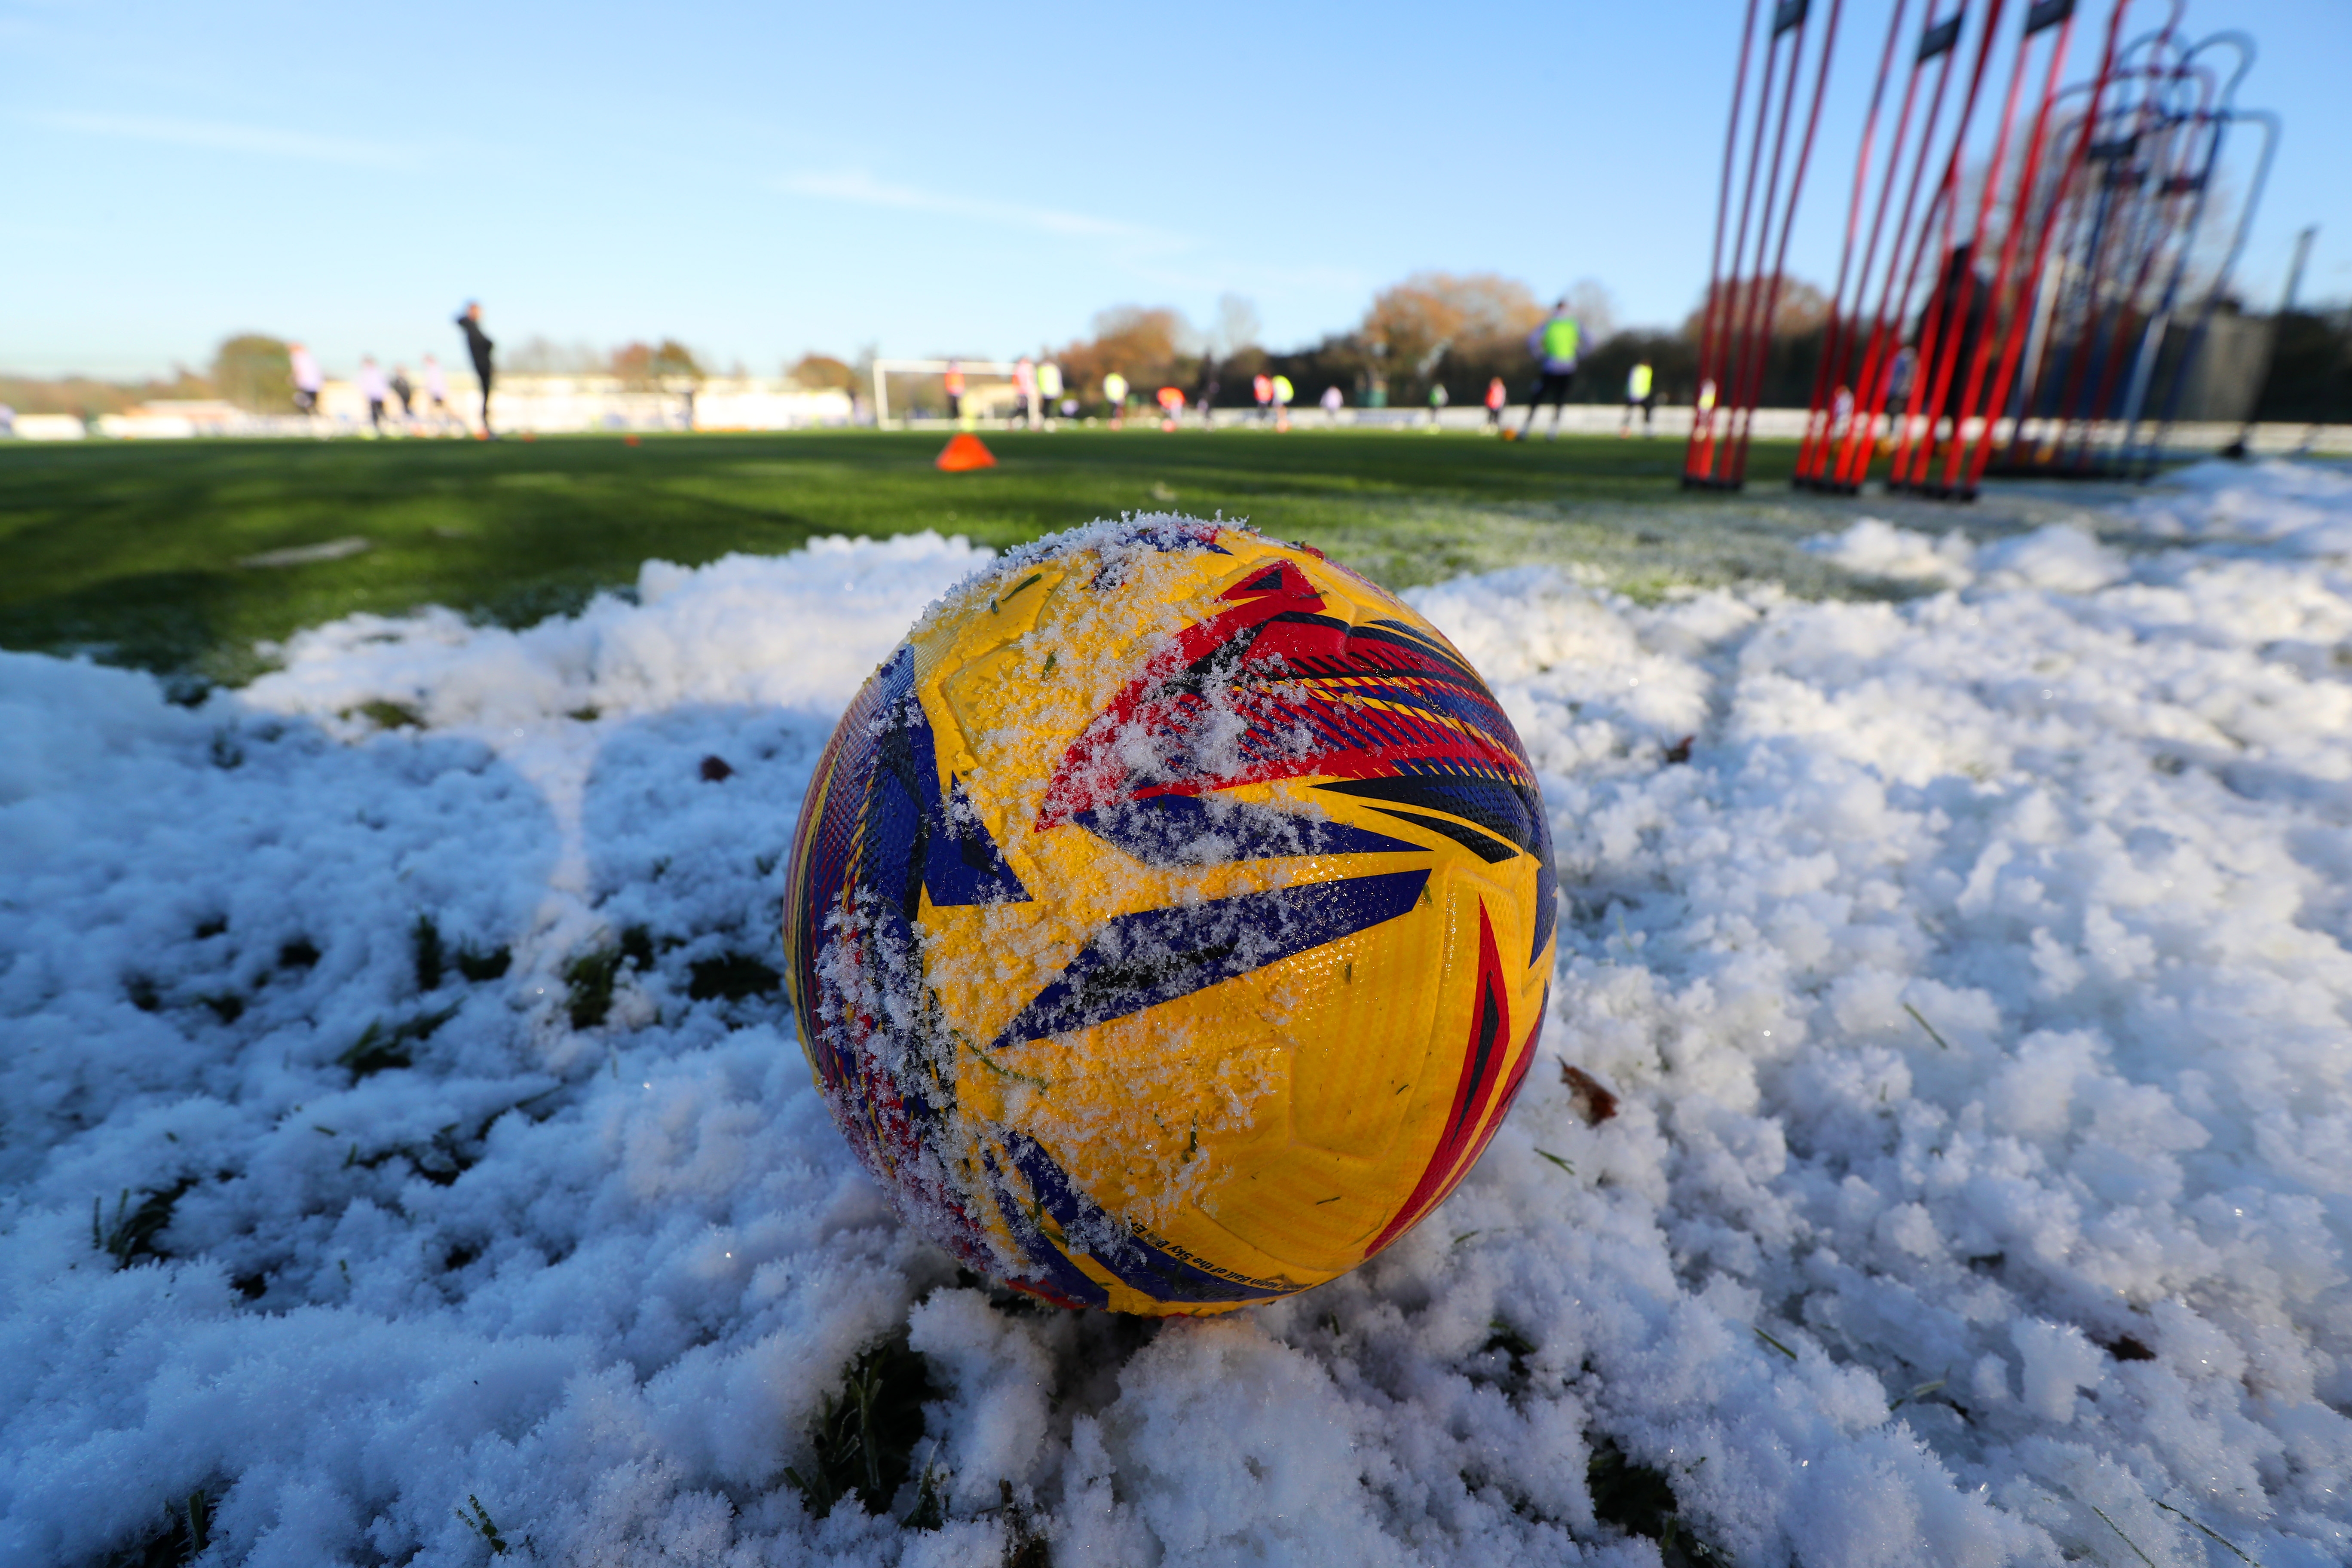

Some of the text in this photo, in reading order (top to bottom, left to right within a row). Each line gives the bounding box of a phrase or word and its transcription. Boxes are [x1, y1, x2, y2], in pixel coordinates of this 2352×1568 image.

[1167, 1245, 1194, 1260] Sky
[1193, 1257, 1214, 1270] the
[1225, 1271, 1251, 1283] Ball
